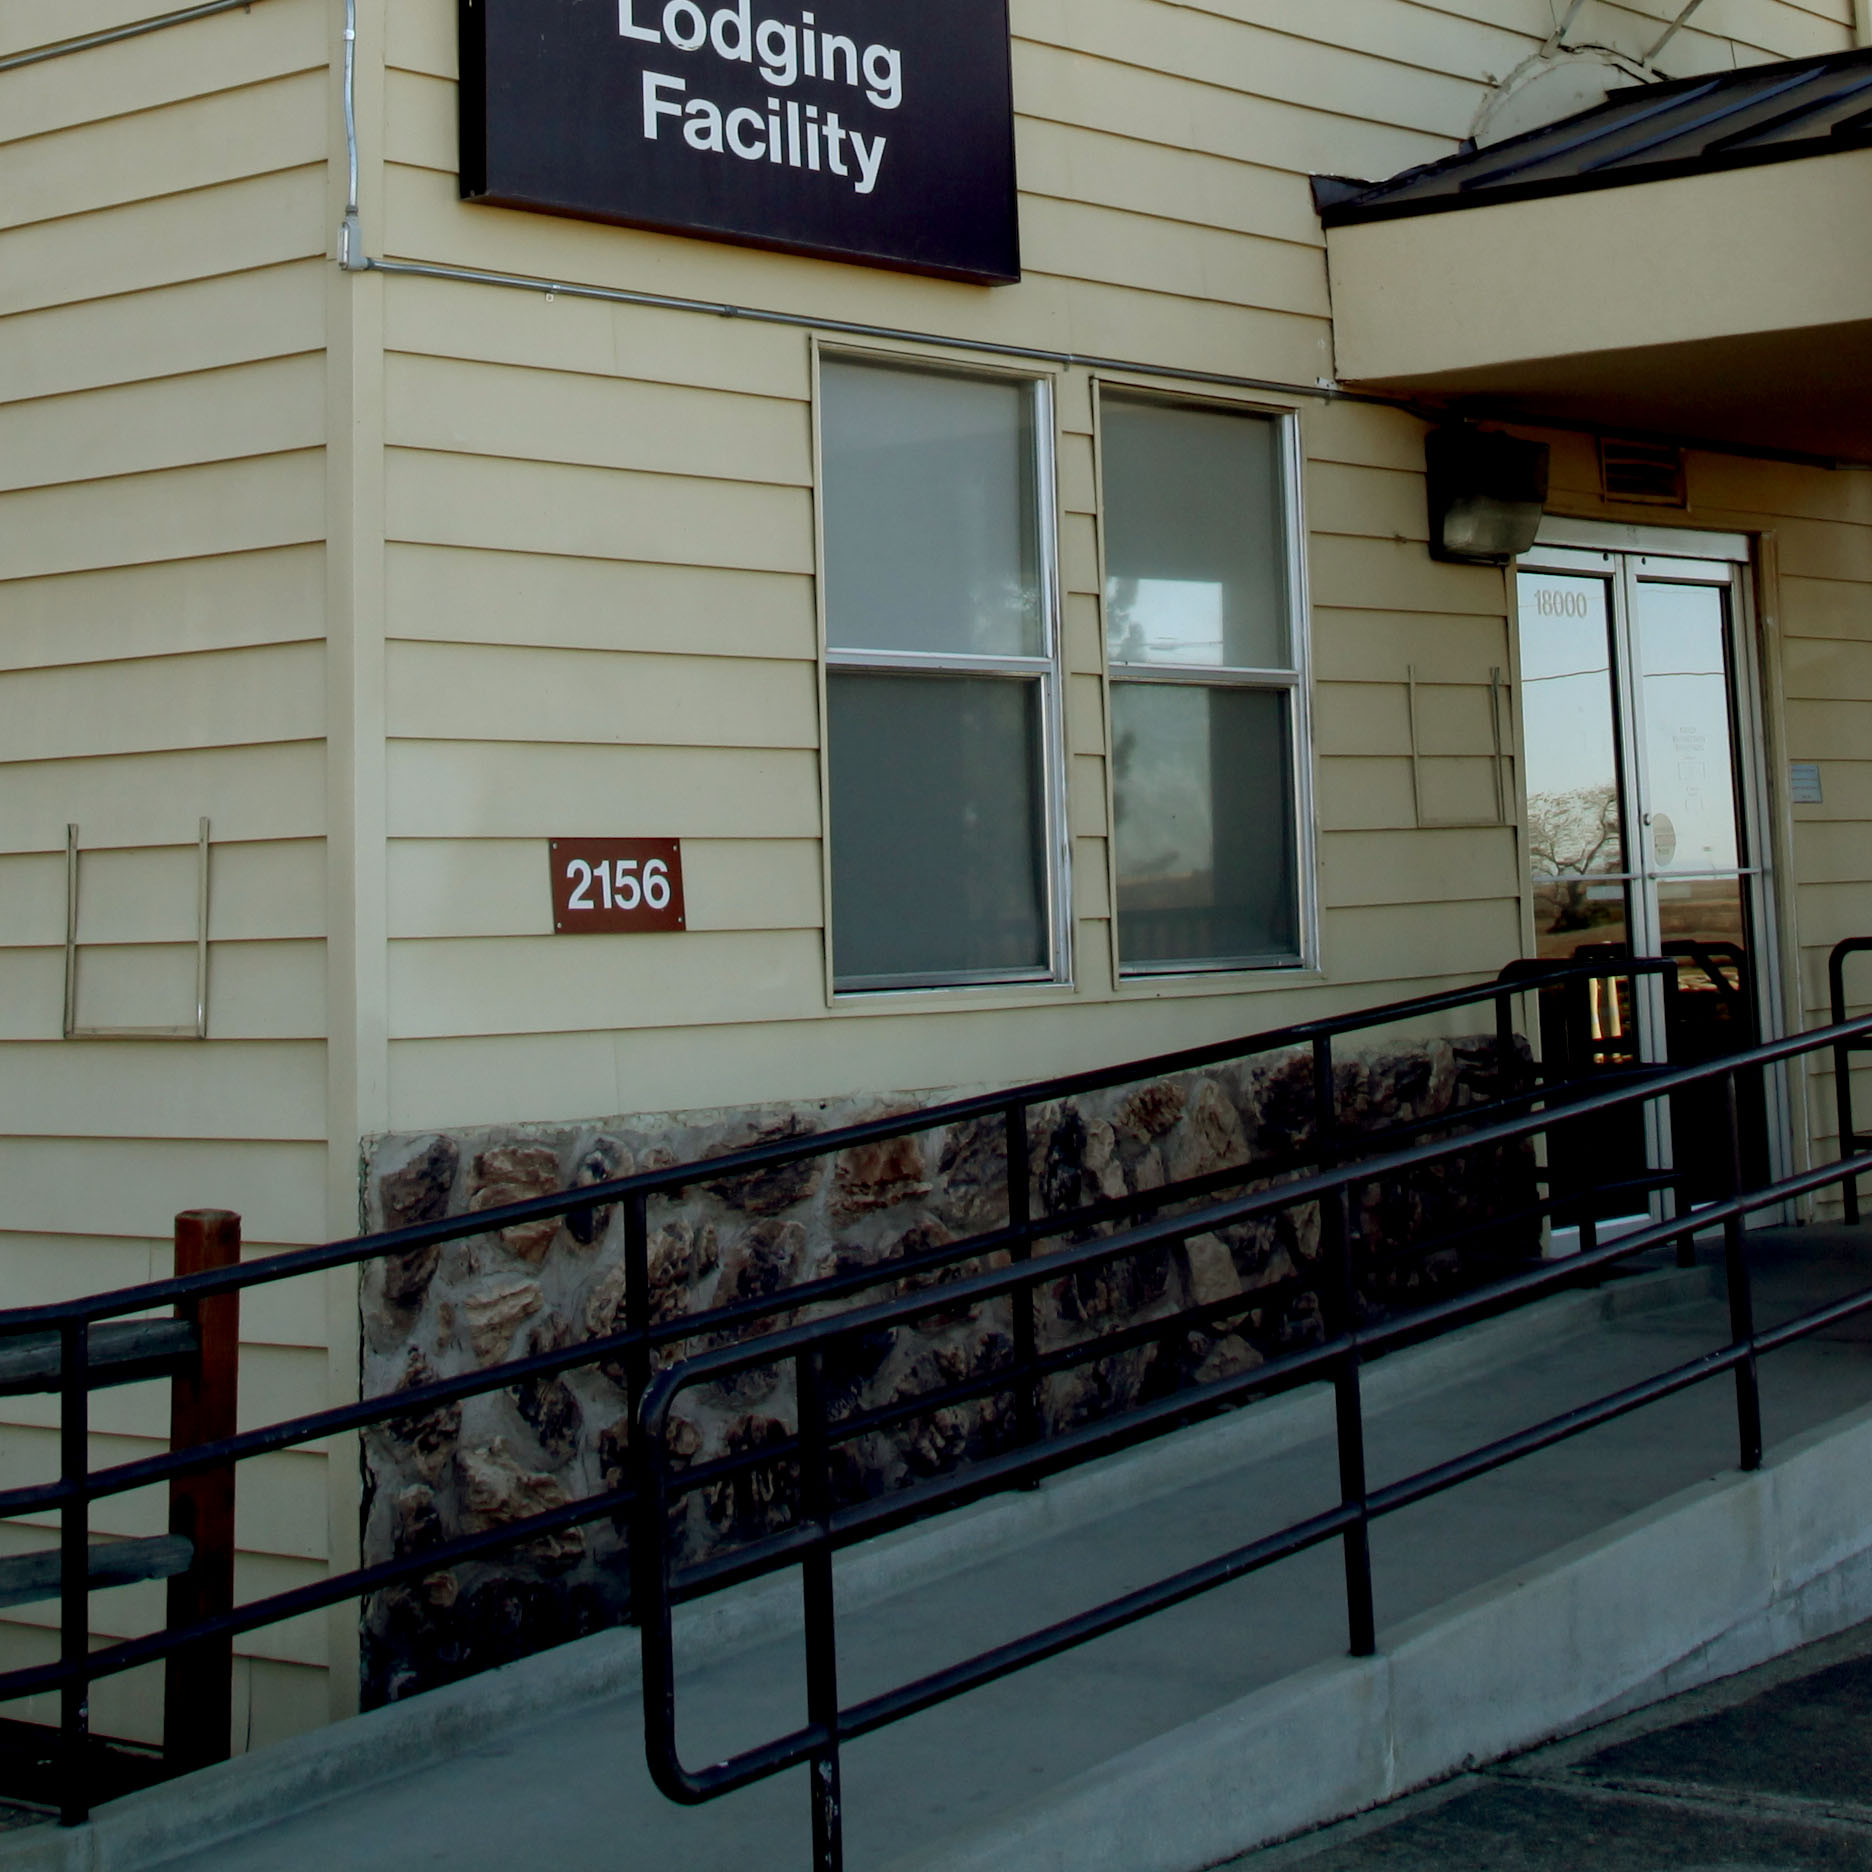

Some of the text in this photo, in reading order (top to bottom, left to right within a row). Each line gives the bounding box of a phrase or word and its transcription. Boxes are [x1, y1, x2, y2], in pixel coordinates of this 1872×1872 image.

[642, 69, 887, 194] Facility
[1534, 589, 1588, 619] 18000
[566, 858, 671, 910] 2156
